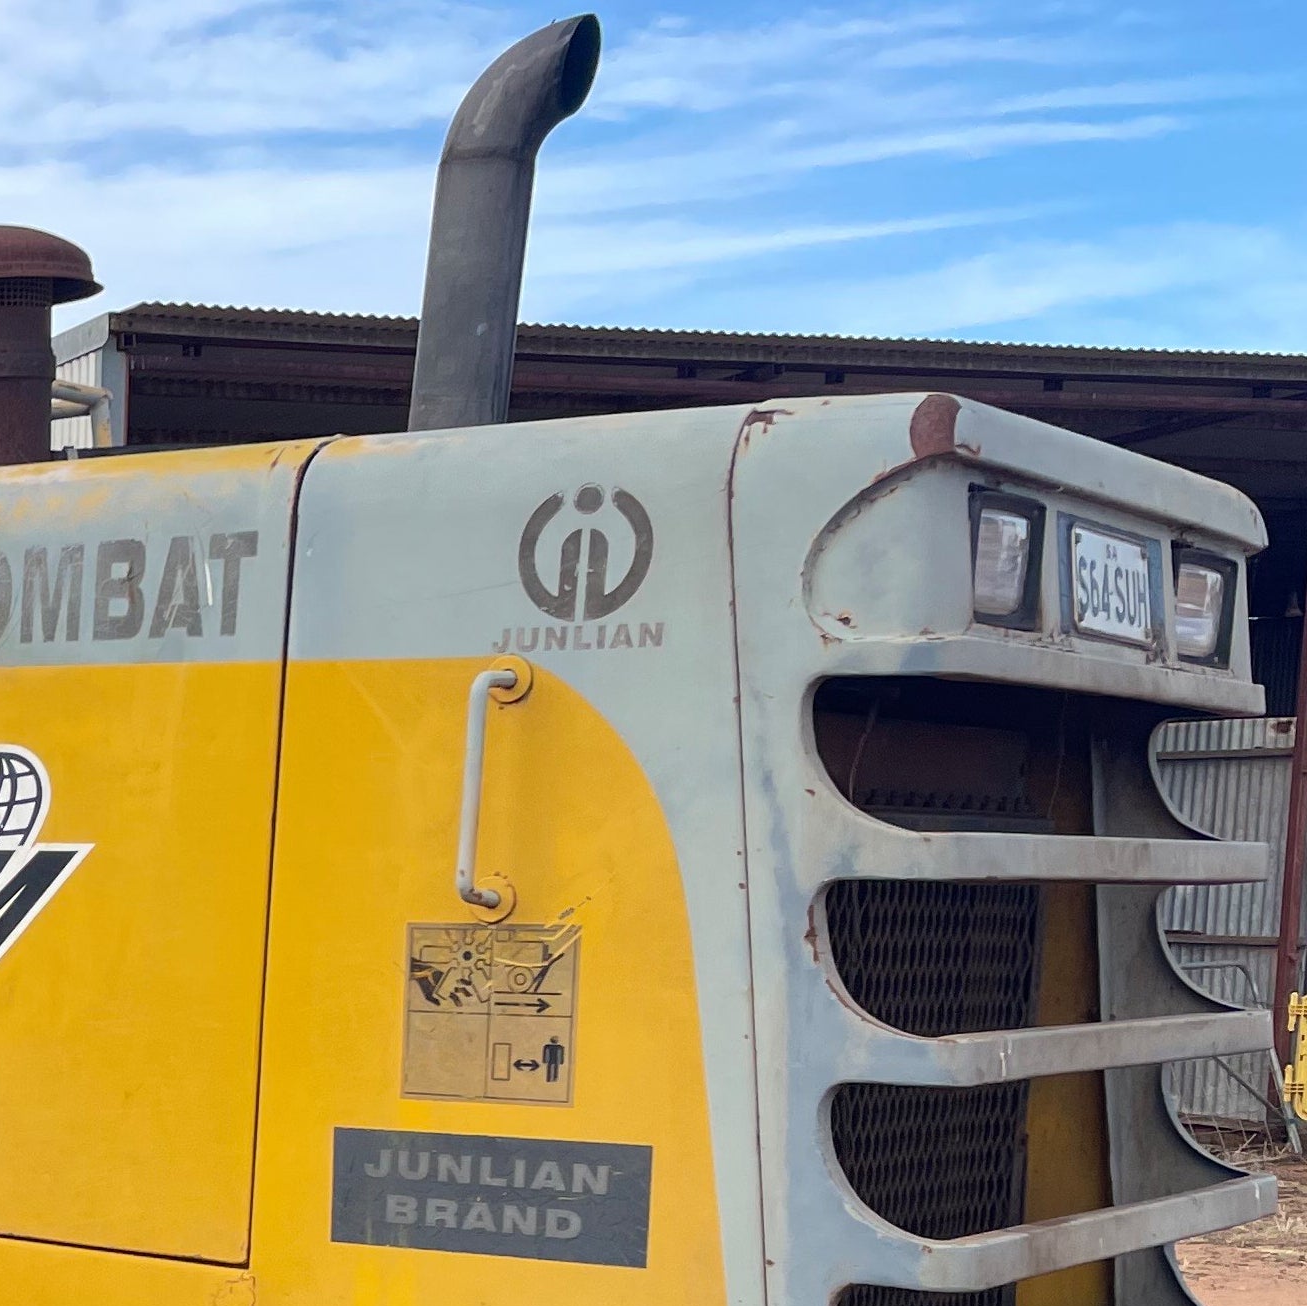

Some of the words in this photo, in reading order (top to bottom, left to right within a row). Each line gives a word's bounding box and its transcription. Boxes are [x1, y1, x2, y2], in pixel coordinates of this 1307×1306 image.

[492, 621, 665, 653] JUNLIAN
[363, 1149, 611, 1195] JUNLIAN
[386, 1193, 584, 1239] BRAND
